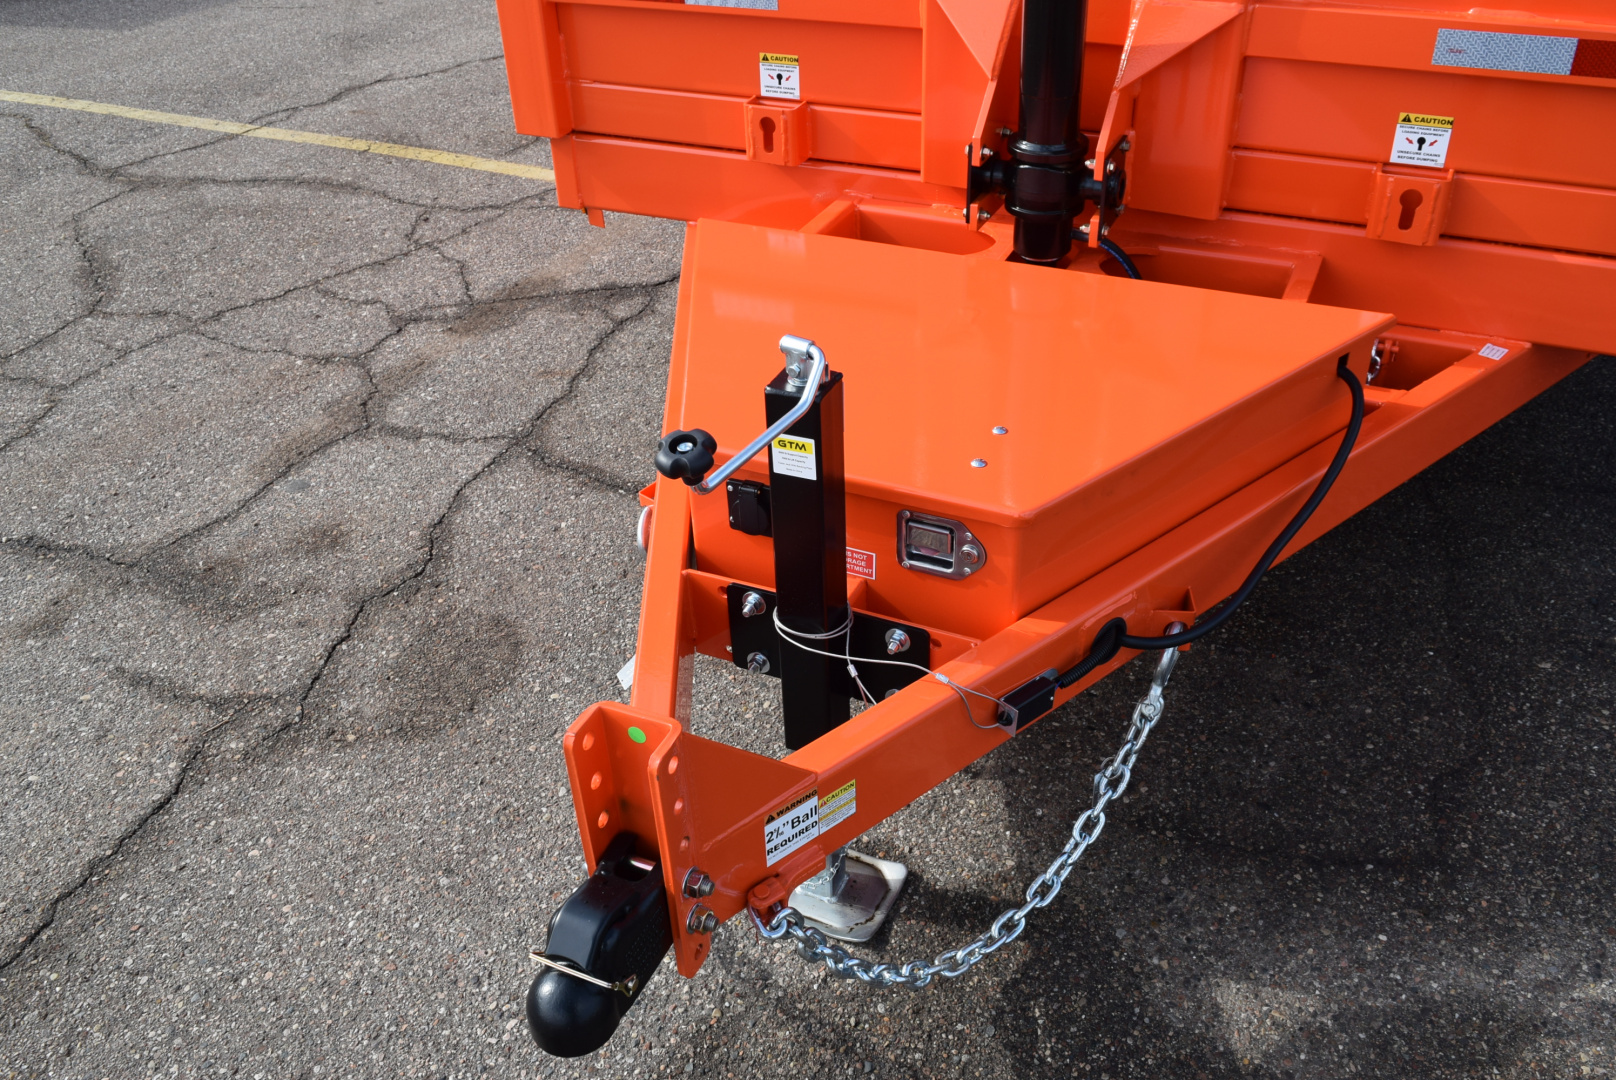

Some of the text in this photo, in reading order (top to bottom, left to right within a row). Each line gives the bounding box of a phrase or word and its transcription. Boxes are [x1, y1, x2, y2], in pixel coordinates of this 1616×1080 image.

[770, 55, 799, 63] CAUTION
[1414, 116, 1454, 126] CAUTION
[777, 439, 807, 452] GTM
[846, 557, 866, 567] RAGE
[853, 552, 867, 561] NOT
[826, 781, 855, 802] CAUTION
[776, 789, 818, 817] WARNING
[790, 804, 818, 830] Ball
[766, 820, 818, 857] REQUIRED
